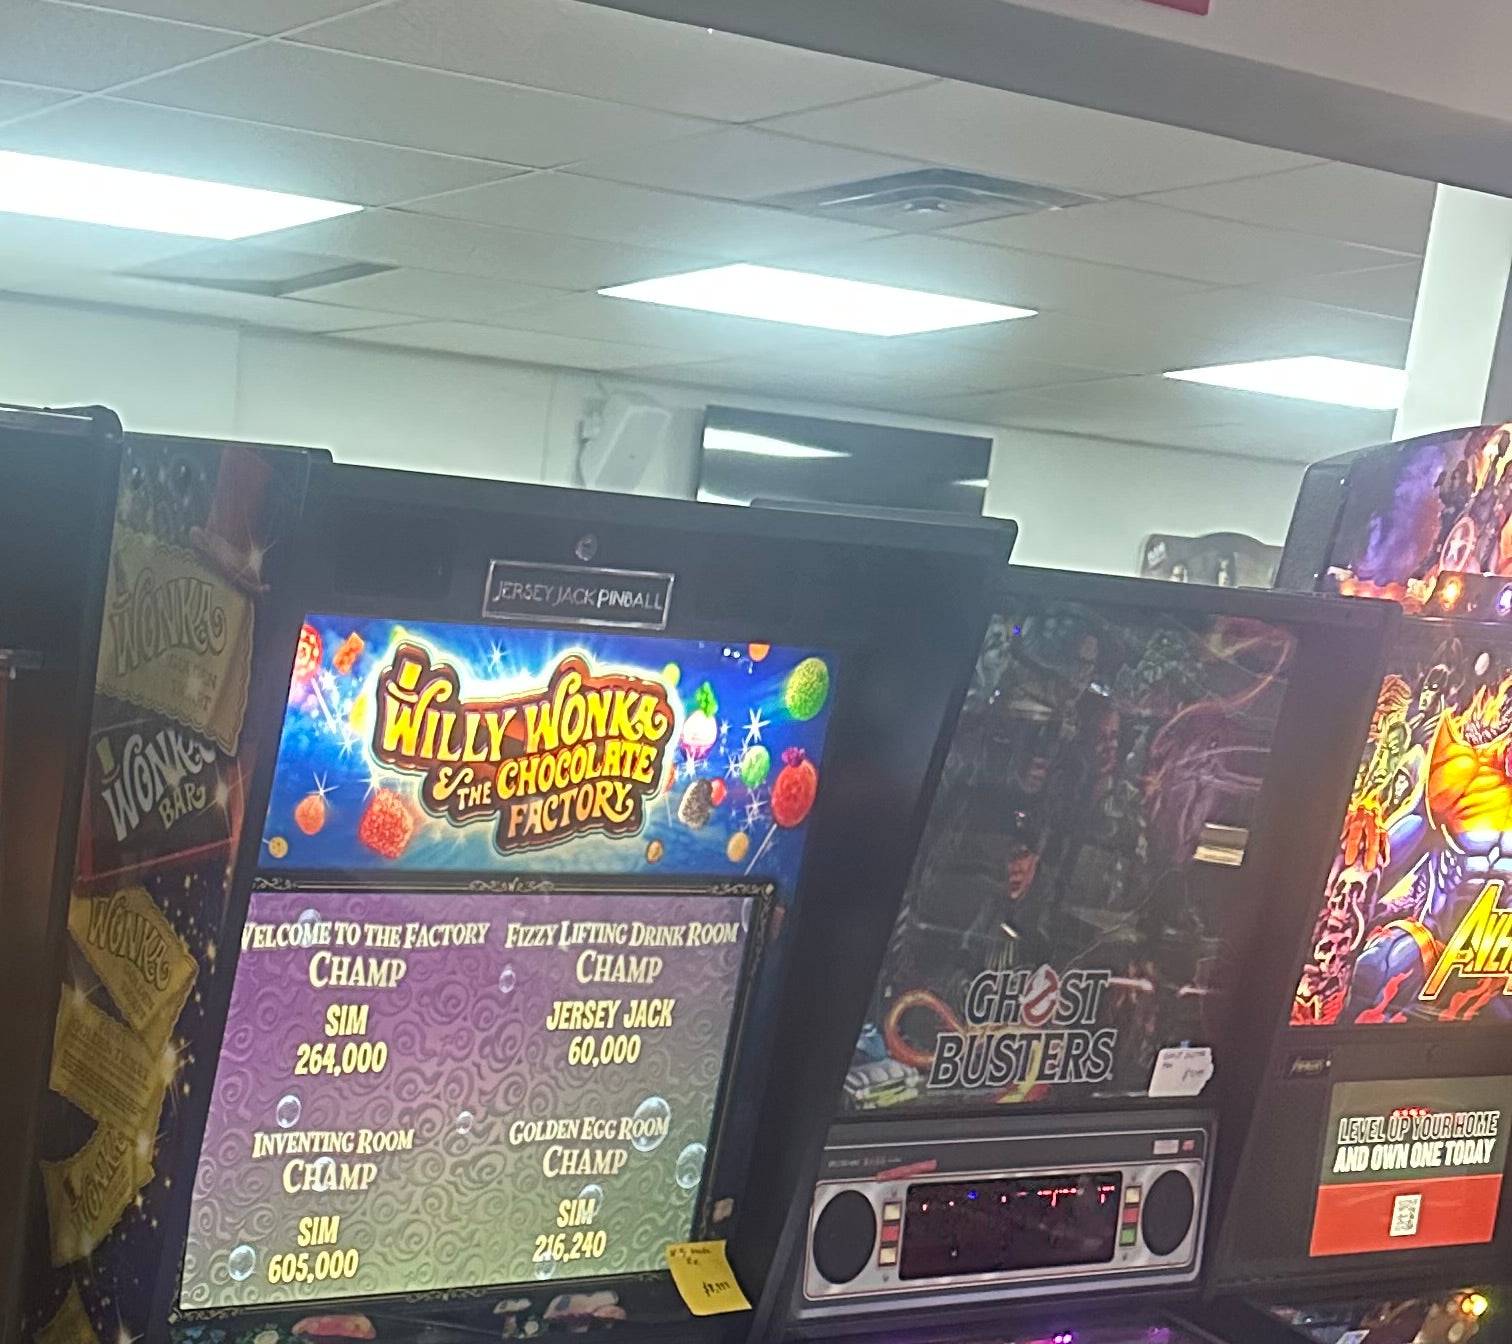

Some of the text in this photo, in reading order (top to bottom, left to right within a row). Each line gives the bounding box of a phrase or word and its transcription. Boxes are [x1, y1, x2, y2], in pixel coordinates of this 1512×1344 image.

[493, 580, 664, 611] JERSEY JACK PINBALL
[109, 567, 226, 675] WONKA
[383, 671, 669, 762] WILLY WONKA
[102, 728, 216, 842] WONKA
[432, 739, 659, 811] & THE CHOCOLATE
[159, 783, 206, 830] BAR
[507, 780, 635, 838] FACTORY
[88, 893, 170, 991] WONKA
[334, 921, 362, 946] TO
[364, 922, 402, 949] THE
[402, 922, 490, 949] FACTORY
[505, 920, 739, 948] FIZZY LIFTING DRINK ROOM
[309, 951, 407, 988] CHAMP
[576, 950, 663, 984] CHAMP
[324, 1004, 369, 1036] SIM
[546, 998, 676, 1031] JERSEY JACK
[294, 1041, 388, 1076] 264,000
[568, 1034, 641, 1068] 60,000
[927, 1029, 1118, 1088] BUSTERS
[251, 1128, 415, 1158] INVENTING ROOM
[509, 1116, 670, 1146] GOLDEN EGG ROOM
[1338, 1110, 1500, 1145] LEVEL UP YOUR HOME
[543, 1145, 628, 1178] CHAMP
[1333, 1138, 1497, 1173] AND OWN ONE TODAY
[282, 1158, 378, 1193] CHAMP
[297, 1215, 340, 1247] SIM
[556, 1198, 597, 1229] SIM
[531, 1230, 607, 1264] 216,240
[268, 1248, 359, 1284] 605,000
